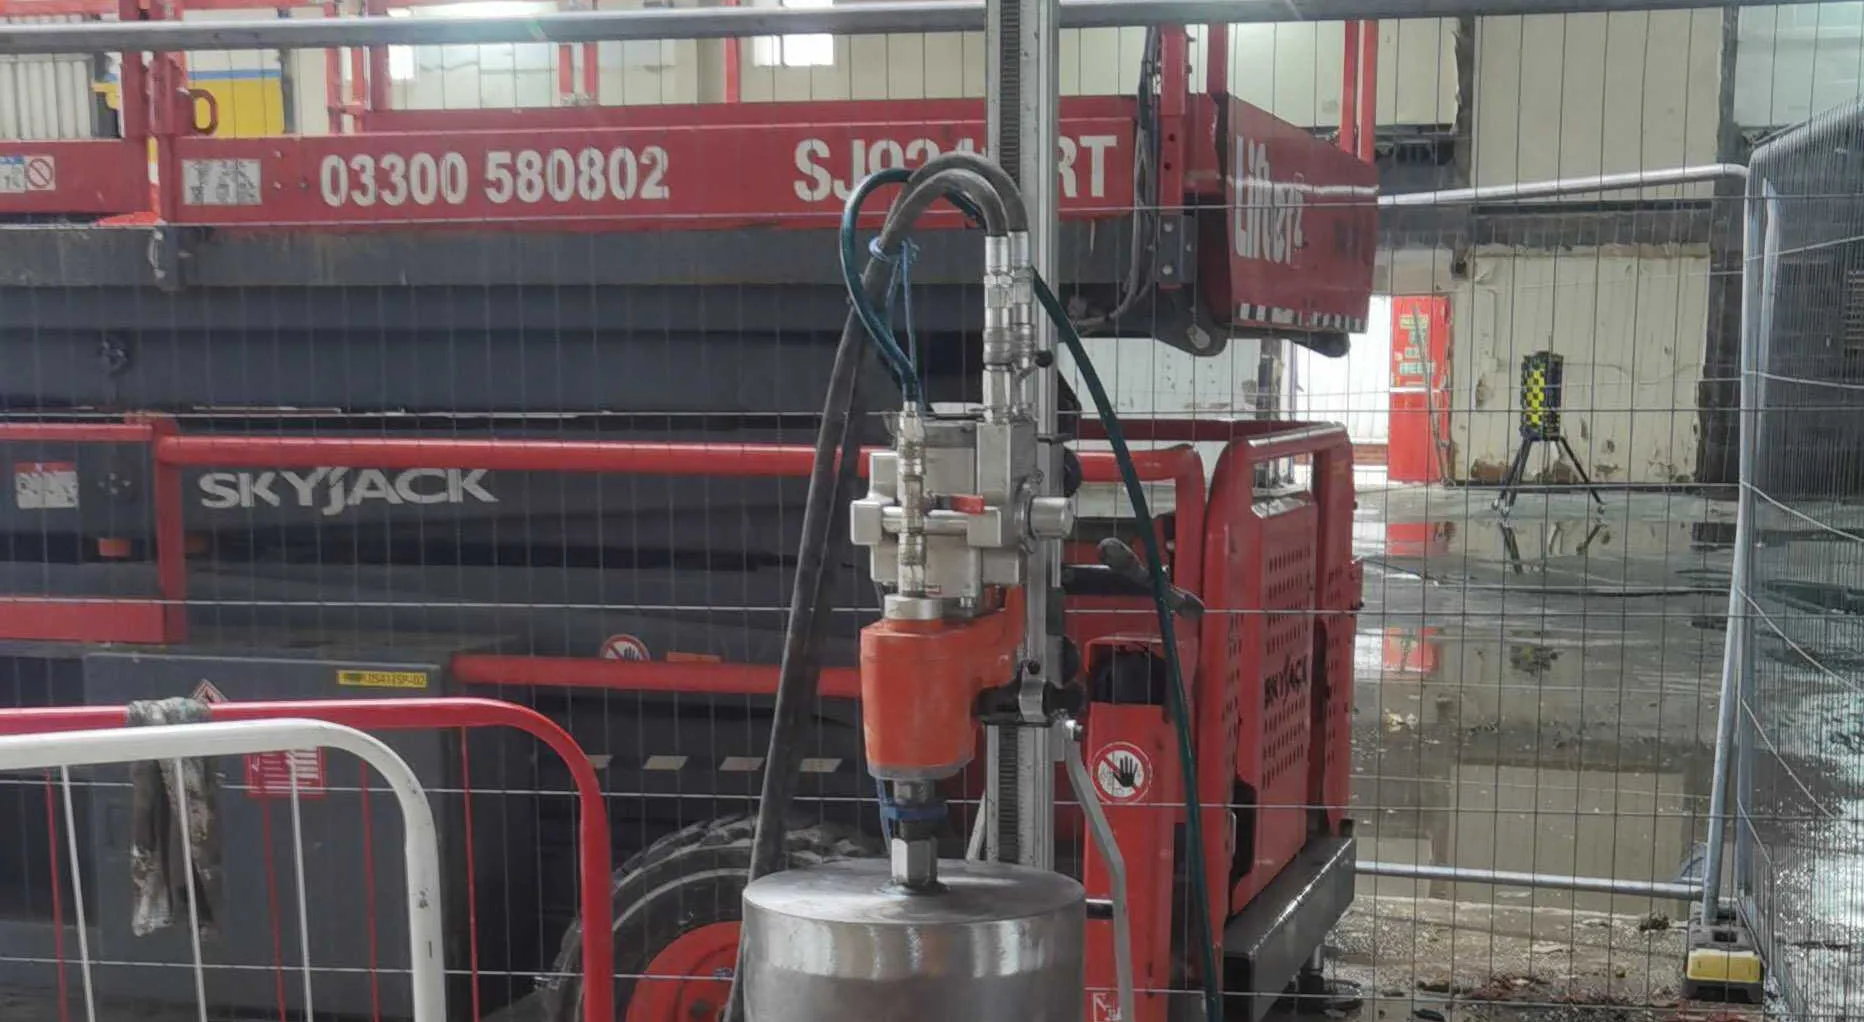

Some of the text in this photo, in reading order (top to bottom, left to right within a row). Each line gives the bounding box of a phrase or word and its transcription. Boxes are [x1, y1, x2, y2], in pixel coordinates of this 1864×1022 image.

[320, 146, 670, 207] 03300 580802
[197, 466, 499, 516] SKYJACK
